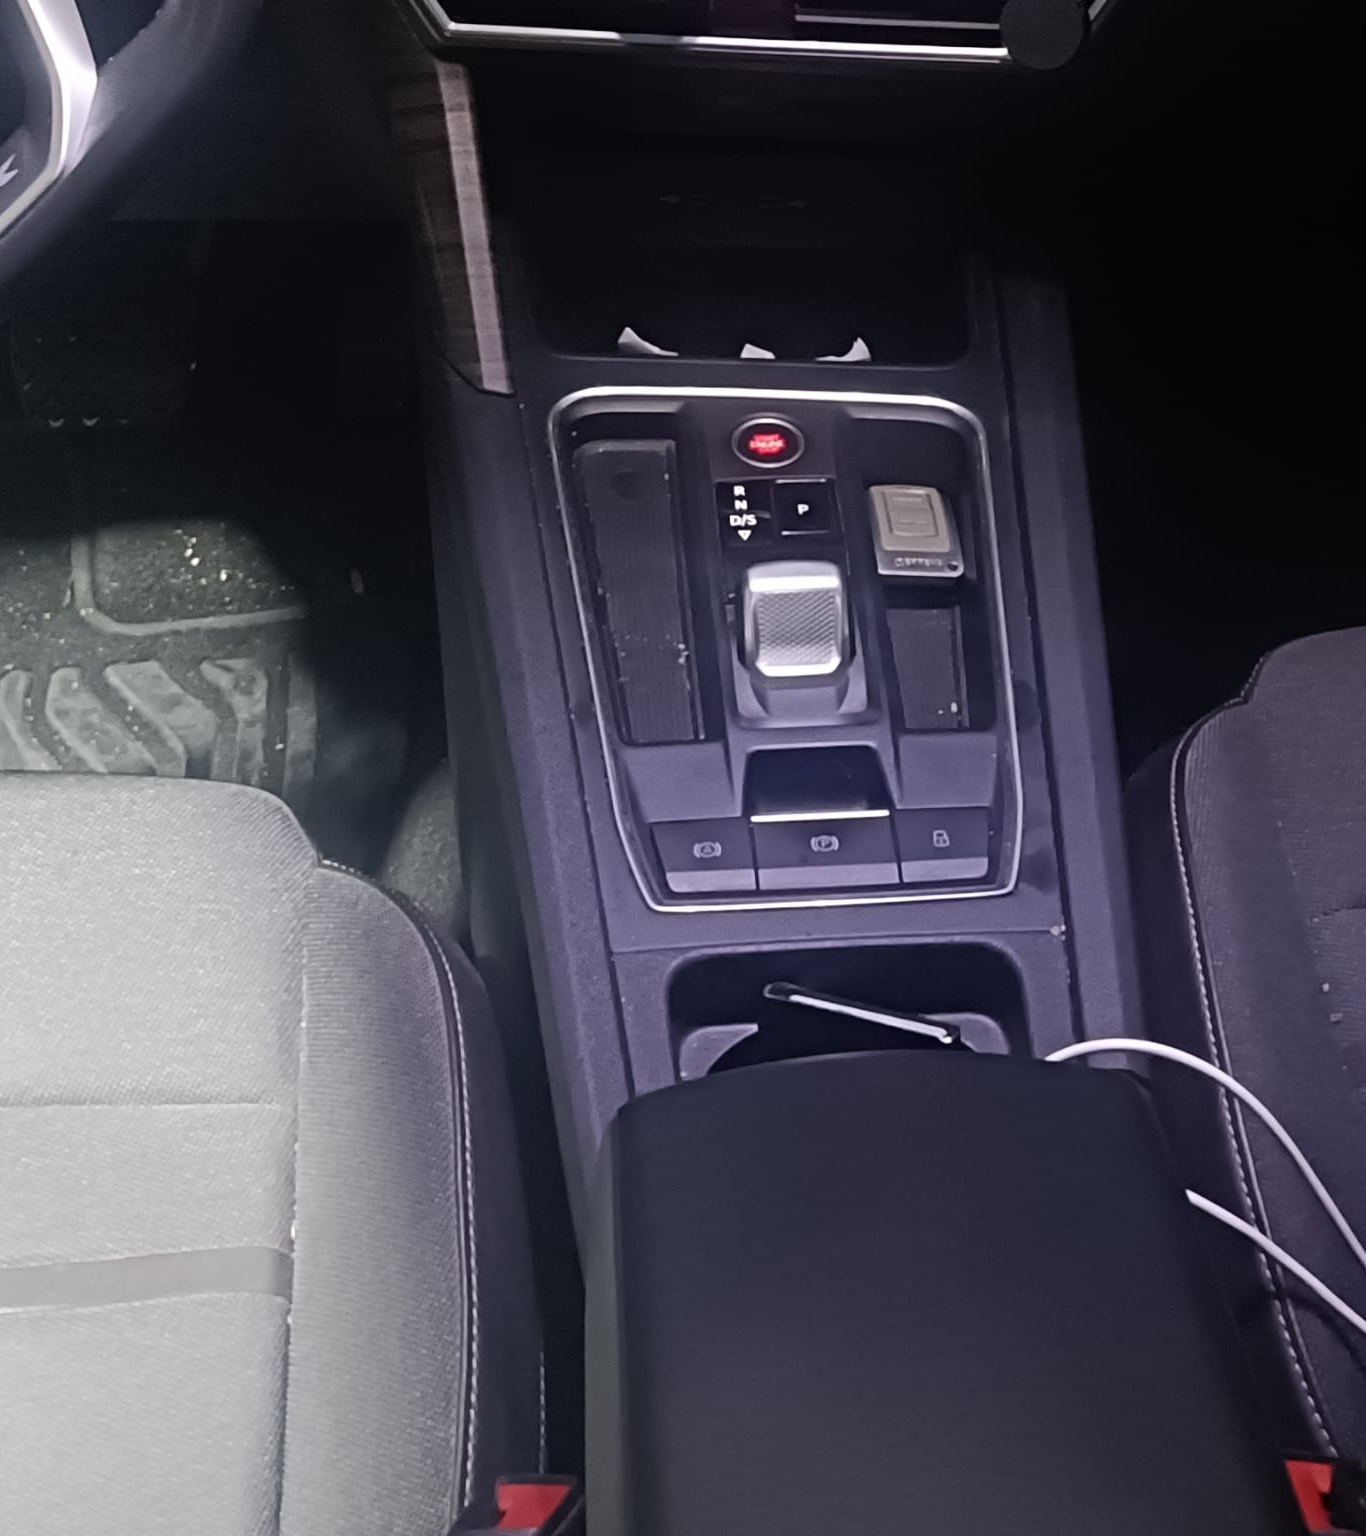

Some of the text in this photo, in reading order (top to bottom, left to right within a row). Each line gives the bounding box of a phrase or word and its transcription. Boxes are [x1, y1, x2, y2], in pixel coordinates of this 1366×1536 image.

[733, 485, 746, 496] R
[734, 499, 748, 511] N
[797, 503, 810, 515] P
[729, 513, 757, 527] D/S
